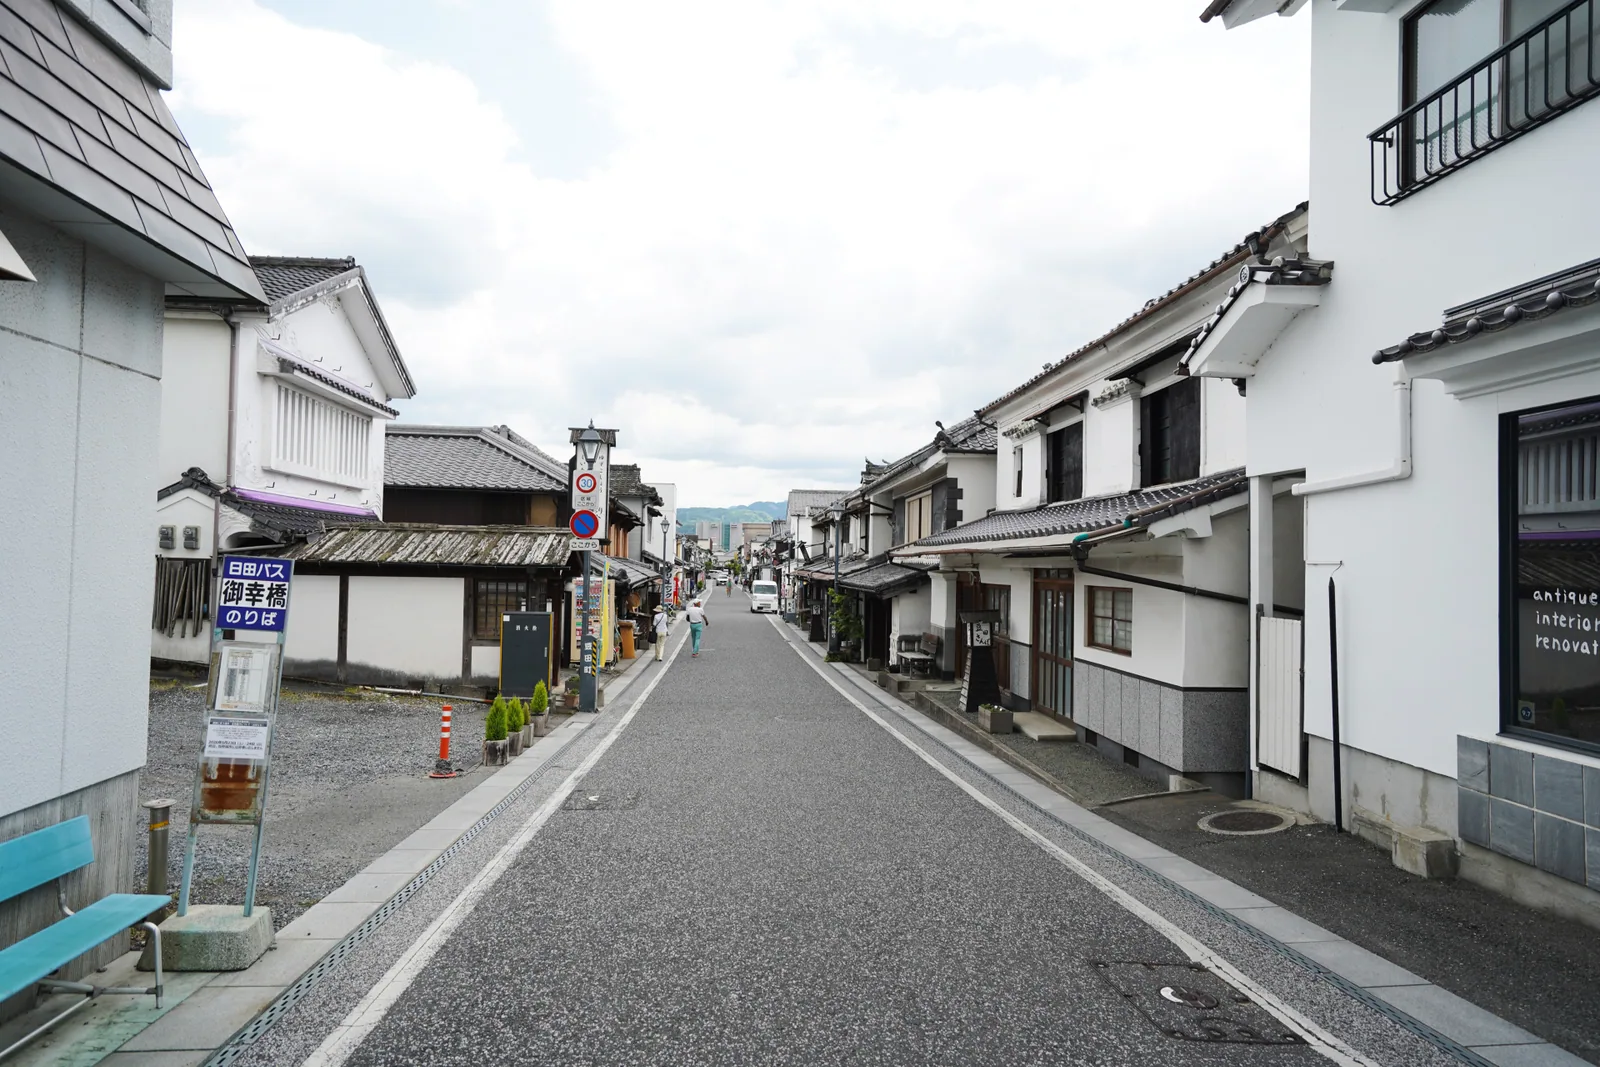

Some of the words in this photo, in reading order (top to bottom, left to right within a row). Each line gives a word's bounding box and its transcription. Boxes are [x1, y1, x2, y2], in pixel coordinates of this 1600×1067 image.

[580, 478, 593, 488] 30
[228, 561, 285, 579] 日田バス
[222, 580, 287, 609] 御幸橋
[1533, 587, 1599, 606] antique
[226, 610, 278, 626] のりば
[1536, 634, 1600, 656] renovat
[583, 642, 593, 674] 豆田町
